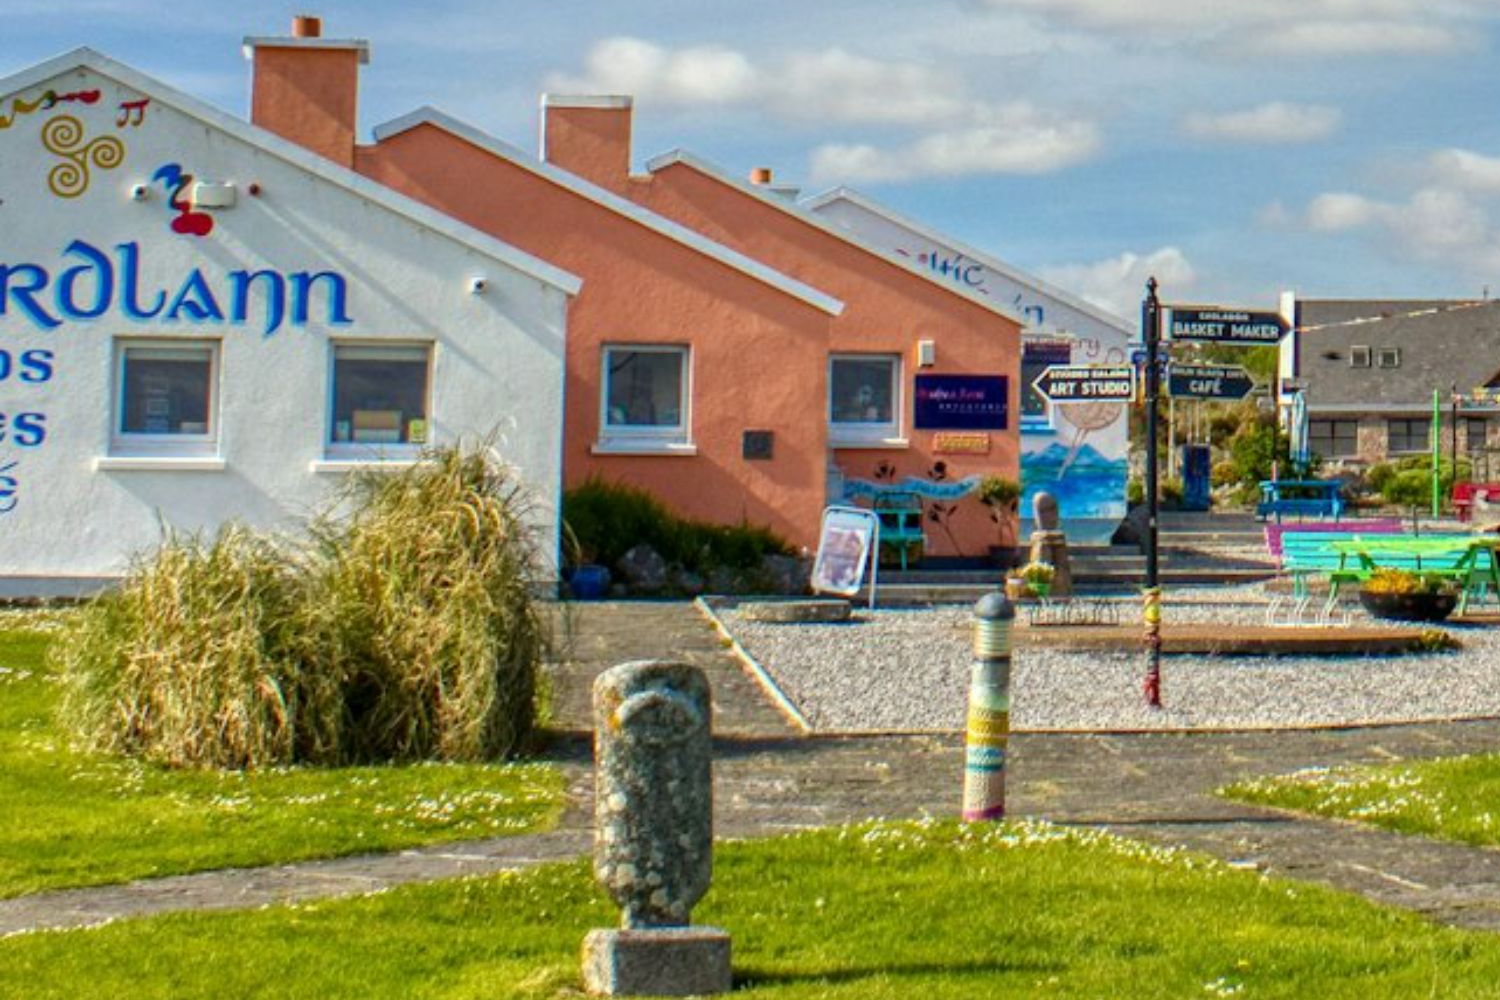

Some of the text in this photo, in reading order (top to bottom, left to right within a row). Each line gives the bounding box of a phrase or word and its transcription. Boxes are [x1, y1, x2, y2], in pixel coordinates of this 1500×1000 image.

[1173, 321, 1279, 339] BASKET MAKER
[1049, 381, 1131, 396] ART STUDIO
